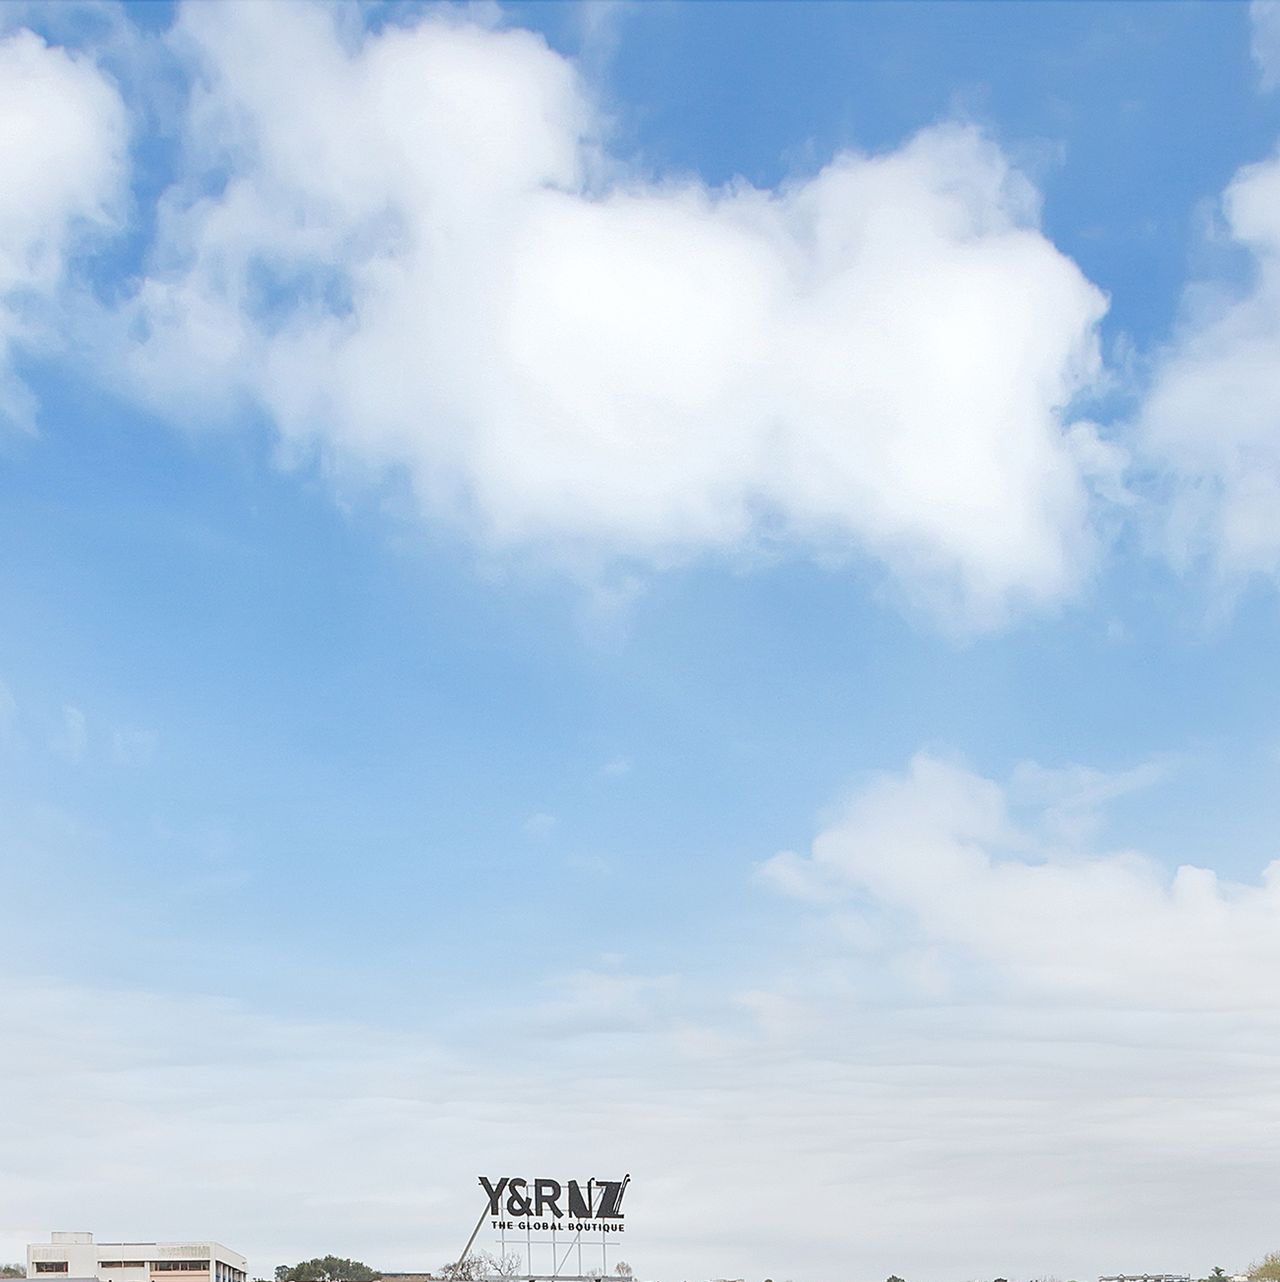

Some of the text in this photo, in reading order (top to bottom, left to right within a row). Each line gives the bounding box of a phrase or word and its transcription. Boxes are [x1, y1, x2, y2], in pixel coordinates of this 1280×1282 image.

[491, 1221, 625, 1232] THE GLOBAL BOUTIQUE
